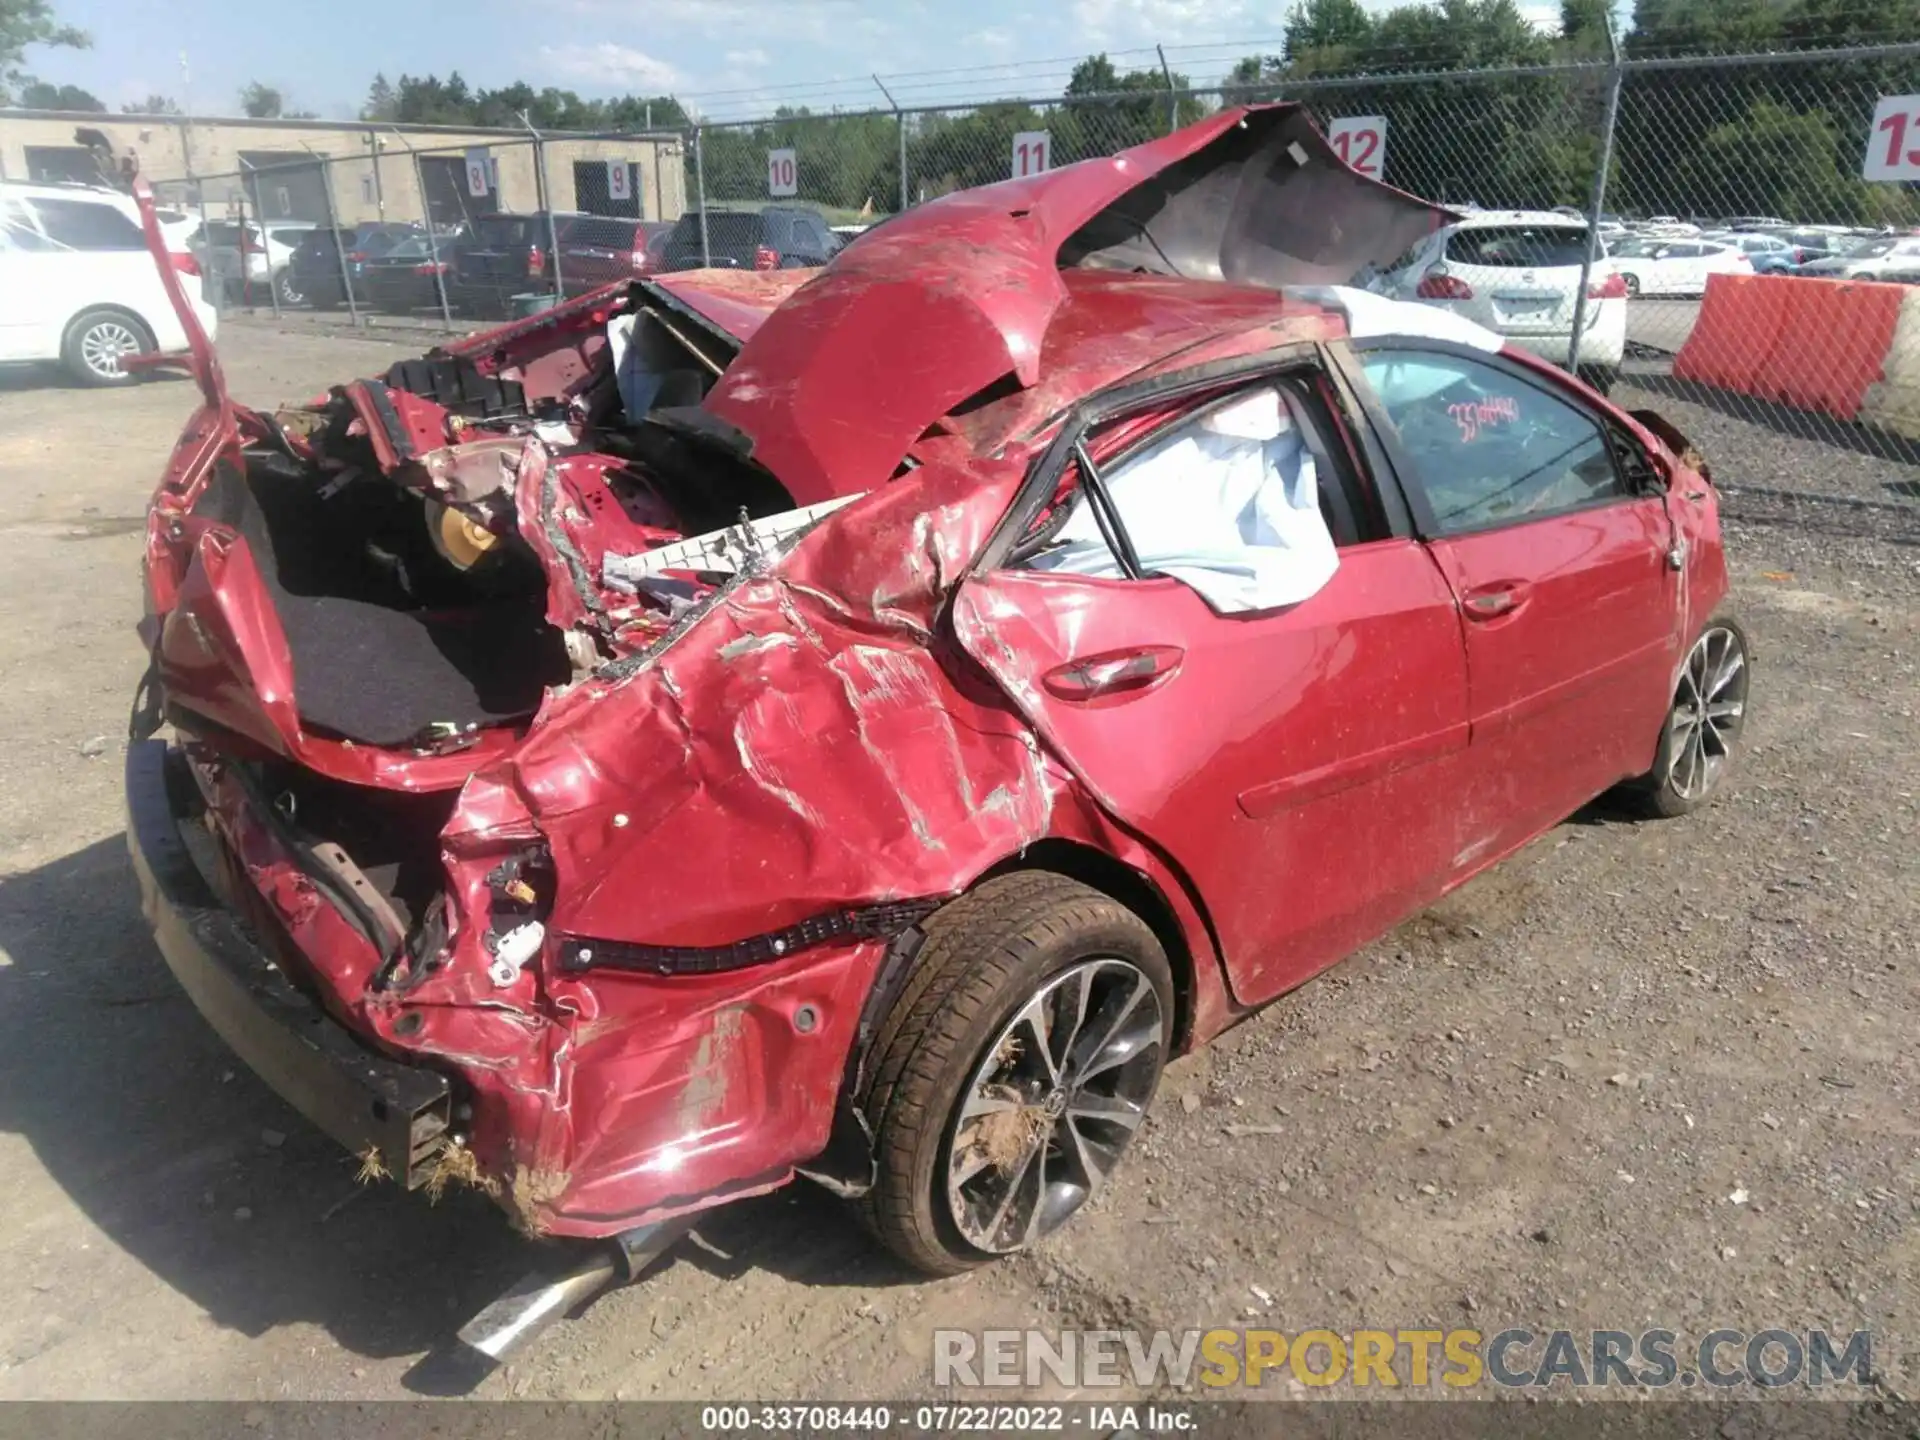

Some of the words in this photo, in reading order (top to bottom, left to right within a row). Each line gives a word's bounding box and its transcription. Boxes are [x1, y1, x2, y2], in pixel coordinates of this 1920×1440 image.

[1018, 142, 1044, 176] 11
[1334, 129, 1378, 172] 12
[470, 167, 483, 190] 8
[613, 166, 624, 193] 9
[771, 159, 793, 187] 10
